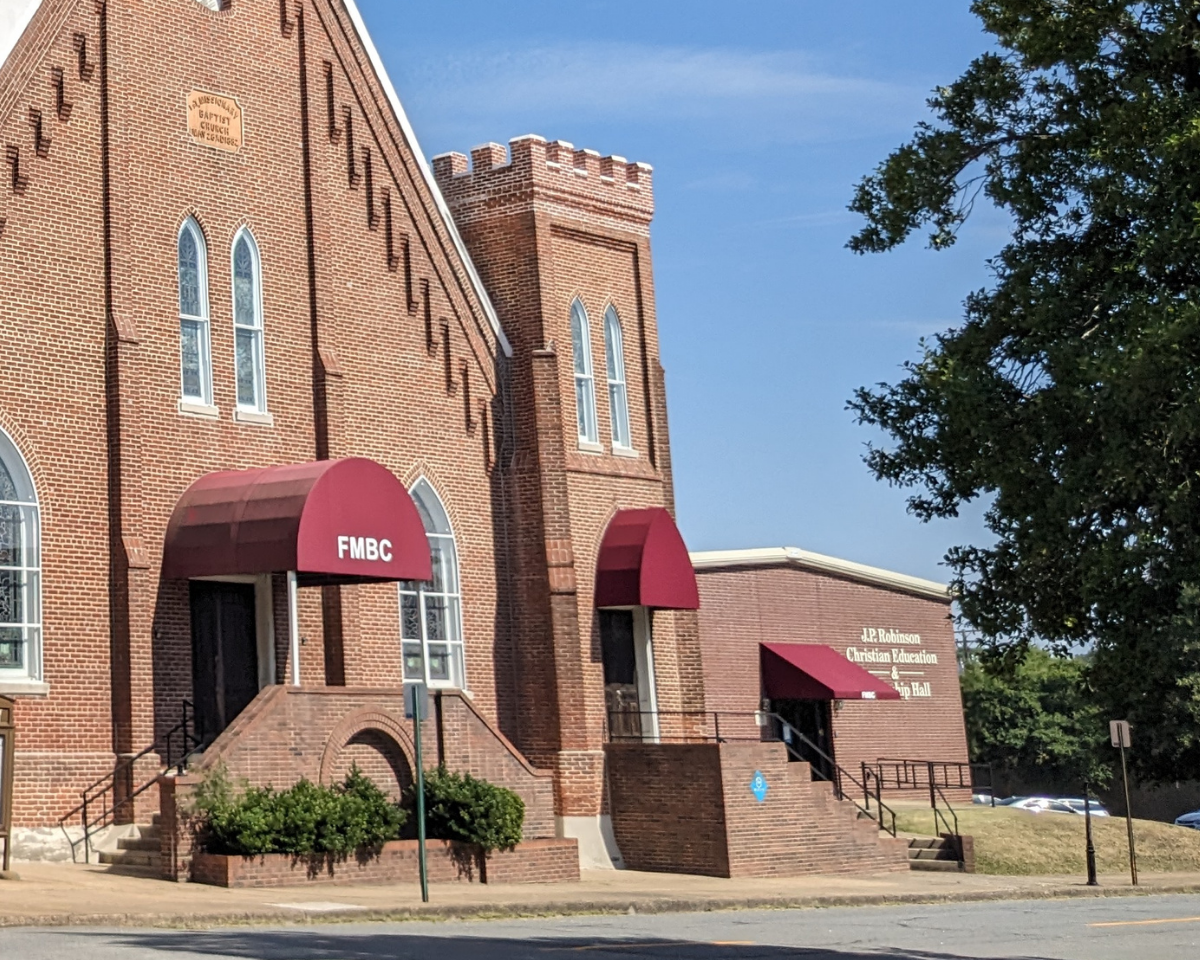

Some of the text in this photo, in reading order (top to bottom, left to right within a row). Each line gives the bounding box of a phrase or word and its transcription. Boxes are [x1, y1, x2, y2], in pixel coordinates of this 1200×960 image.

[199, 109, 230, 126] BAPTIST
[200, 121, 230, 136] CHURCH
[337, 535, 393, 562] FMBC
[861, 627, 921, 644] J.P. Robinson
[846, 646, 938, 664] Christian Education
[891, 665, 899, 680] &
[910, 681, 931, 696] Hall
